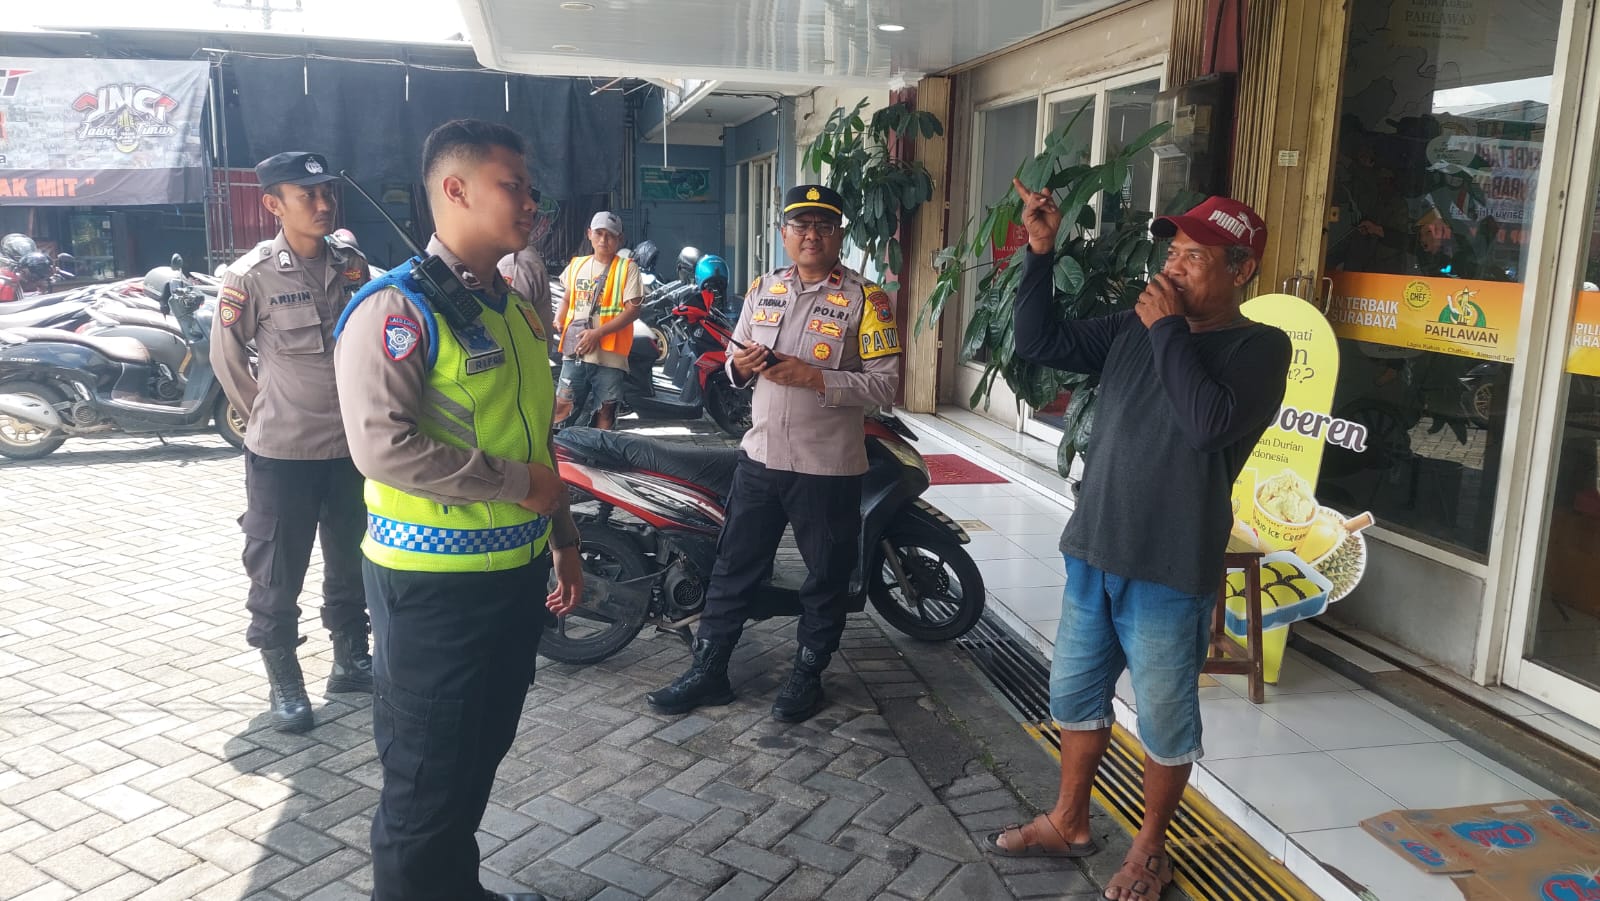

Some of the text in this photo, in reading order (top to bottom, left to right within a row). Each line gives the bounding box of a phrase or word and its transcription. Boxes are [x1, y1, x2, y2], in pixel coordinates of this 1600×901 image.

[36, 177, 78, 197] MIT
[1207, 209, 1247, 239] PUMA
[270, 291, 311, 306] ARIFIN
[1410, 291, 1427, 302] CHEF
[813, 305, 850, 322] POLRI
[1347, 297, 1399, 315] TERBAIK
[1332, 309, 1398, 330] SURABAYA
[1424, 324, 1499, 344] PAHLAWAN
[1273, 438, 1304, 453] Durian
[1250, 450, 1289, 464] ndonesia
